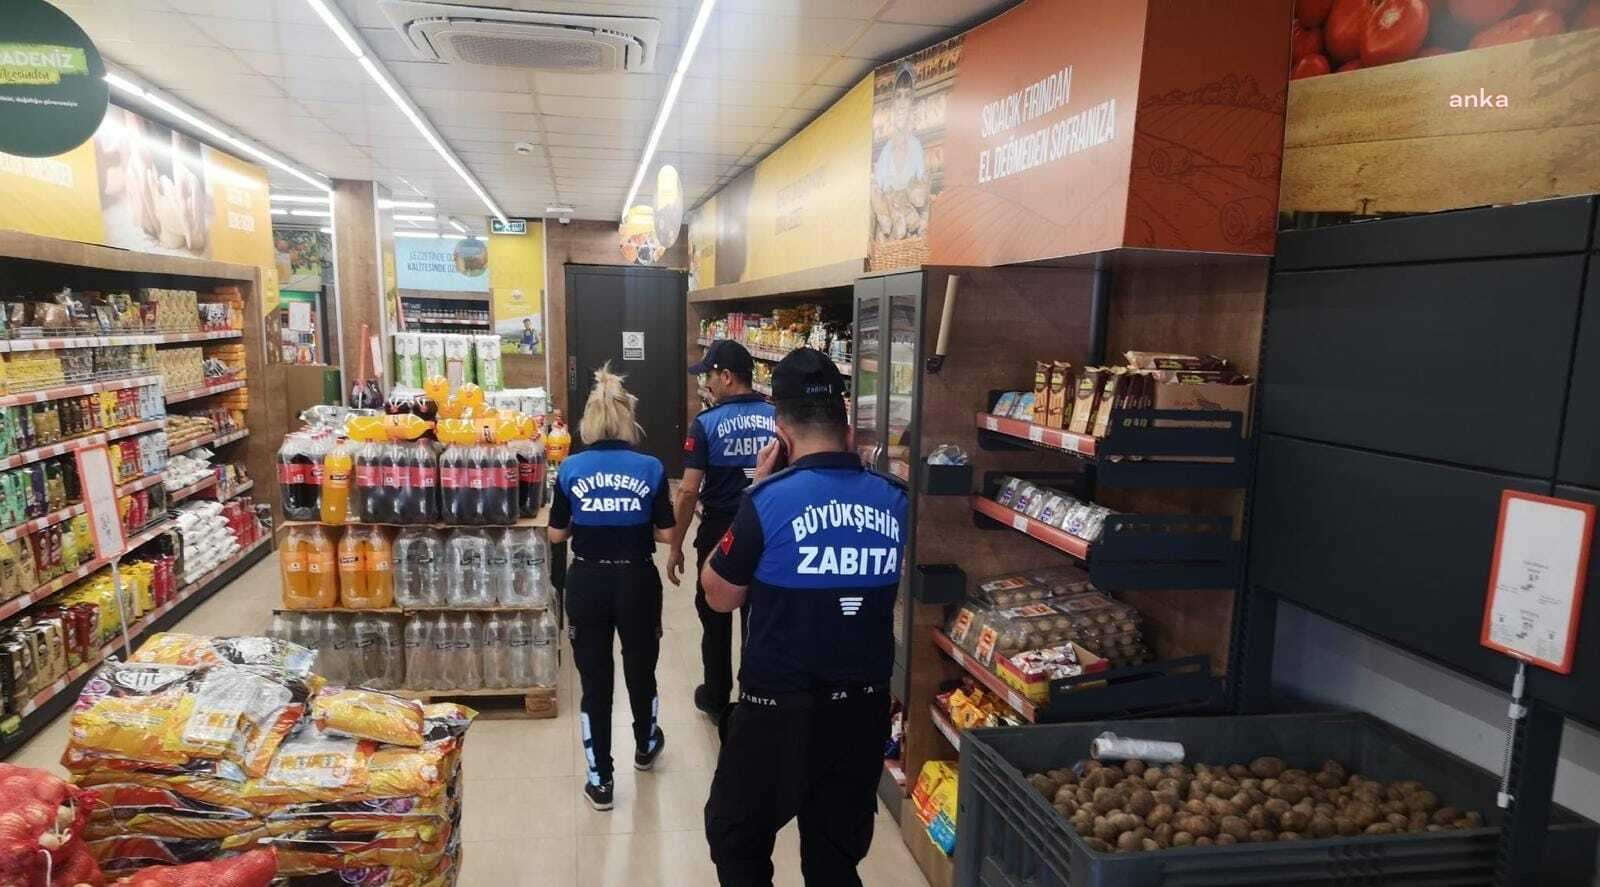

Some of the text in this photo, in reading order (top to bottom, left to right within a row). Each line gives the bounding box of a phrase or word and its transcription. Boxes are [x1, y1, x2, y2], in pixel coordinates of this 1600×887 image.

[1023, 65, 1072, 122] FIRINDAN
[979, 150, 992, 184] EL
[1050, 98, 1116, 162] SOFRANIZA
[571, 472, 651, 499] BÜYÜKŞEHİR
[581, 497, 642, 511] ZABITA
[791, 499, 900, 543] BÜYÜKŞEHİR
[797, 546, 898, 575] ZABITA
